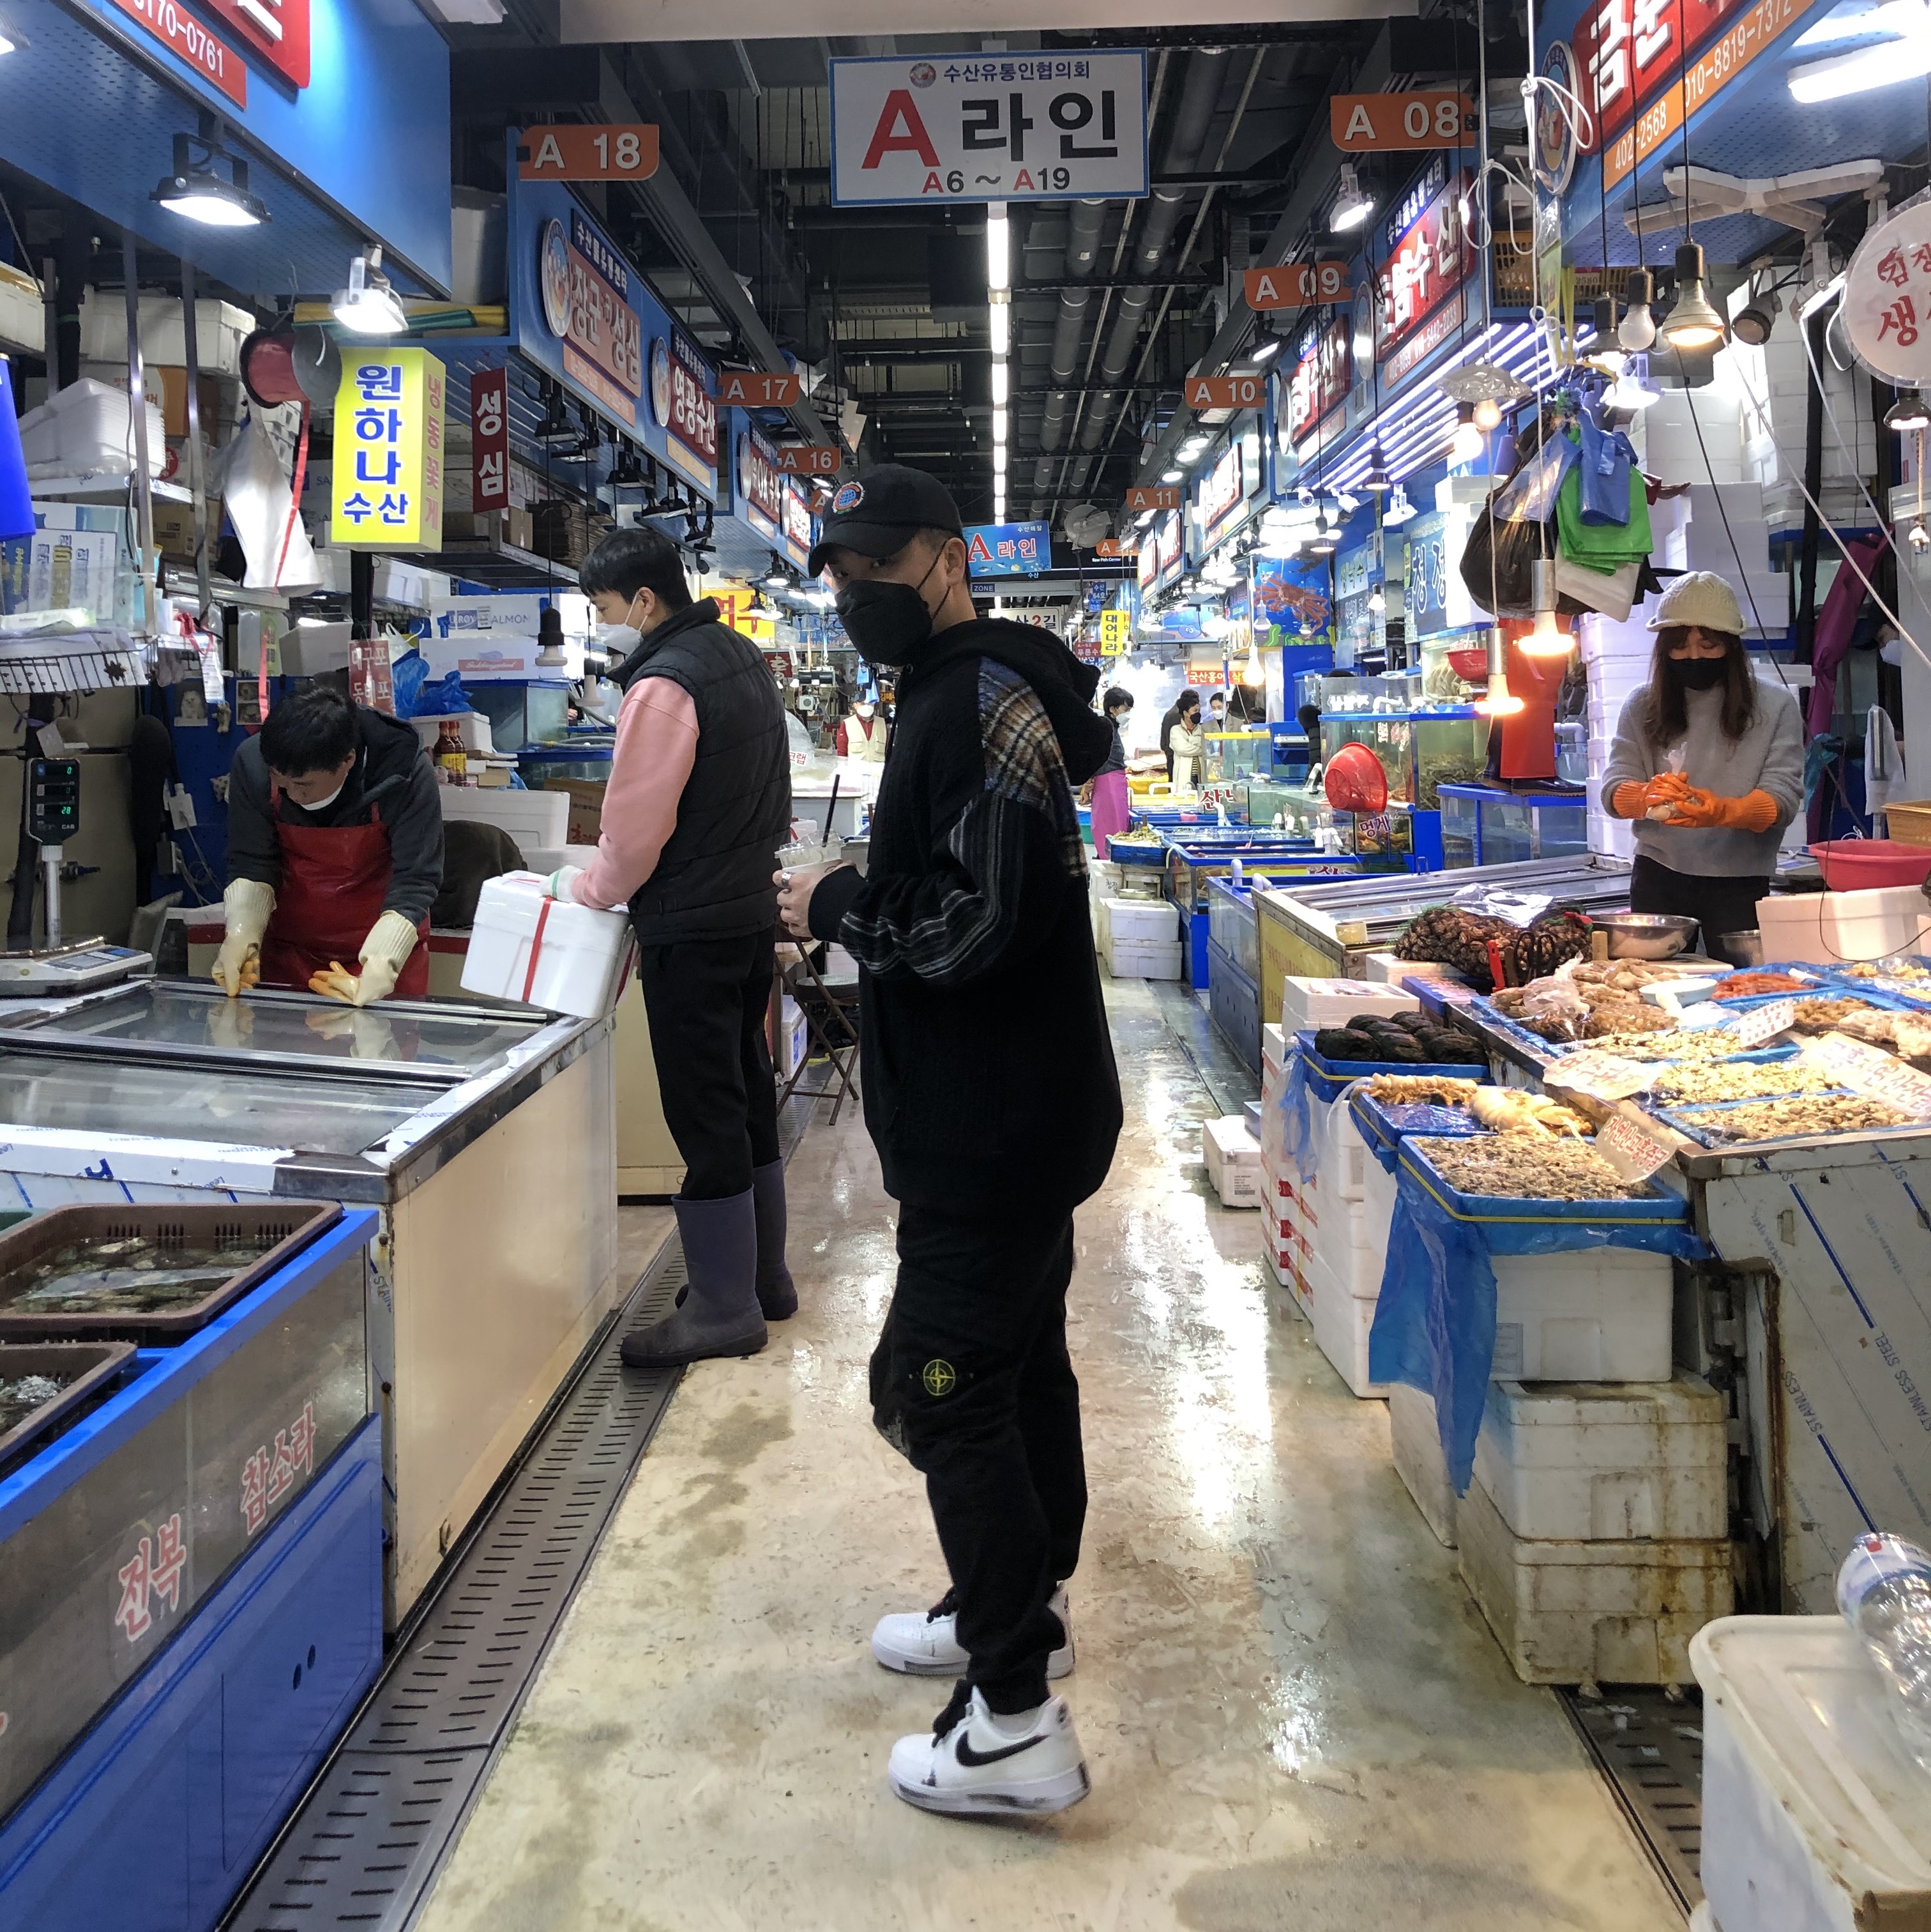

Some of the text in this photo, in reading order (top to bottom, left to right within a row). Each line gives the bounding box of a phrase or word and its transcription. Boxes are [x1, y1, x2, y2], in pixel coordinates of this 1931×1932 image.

[944, 61, 1091, 83] 수산유통인협의회
[861, 89, 1118, 169] A 라인
[1344, 100, 1459, 141] A 08
[534, 132, 641, 170] A 18
[921, 170, 965, 194] A6
[1013, 167, 1071, 191] A19
[1255, 267, 1340, 303] A 09
[1877, 295, 1931, 347] 생
[727, 379, 789, 400] A 17
[1195, 381, 1255, 403] A 10
[355, 365, 404, 485] 원하나
[674, 365, 716, 455] 영광수산
[425, 373, 442, 531] 냉동꽃게
[476, 390, 504, 497] 성심
[783, 452, 833, 469] A 16
[343, 492, 409, 524] 수산
[1133, 491, 1172, 506] A 11
[967, 533, 1037, 563] A 라인
[1100, 542, 1112, 554] A
[1009, 614, 1057, 630] 산2길
[1105, 614, 1119, 652] 대어나라
[1077, 648, 1102, 656] 푸른수
[1232, 671, 1247, 683] 삭
[1358, 814, 1392, 838] 멍게
[1874, 1329, 1931, 1433] STAINLESS STEEL
[1782, 1370, 1824, 1433] STAINLESS
[240, 1400, 316, 1536] 참소라
[114, 1512, 187, 1643] 전복
